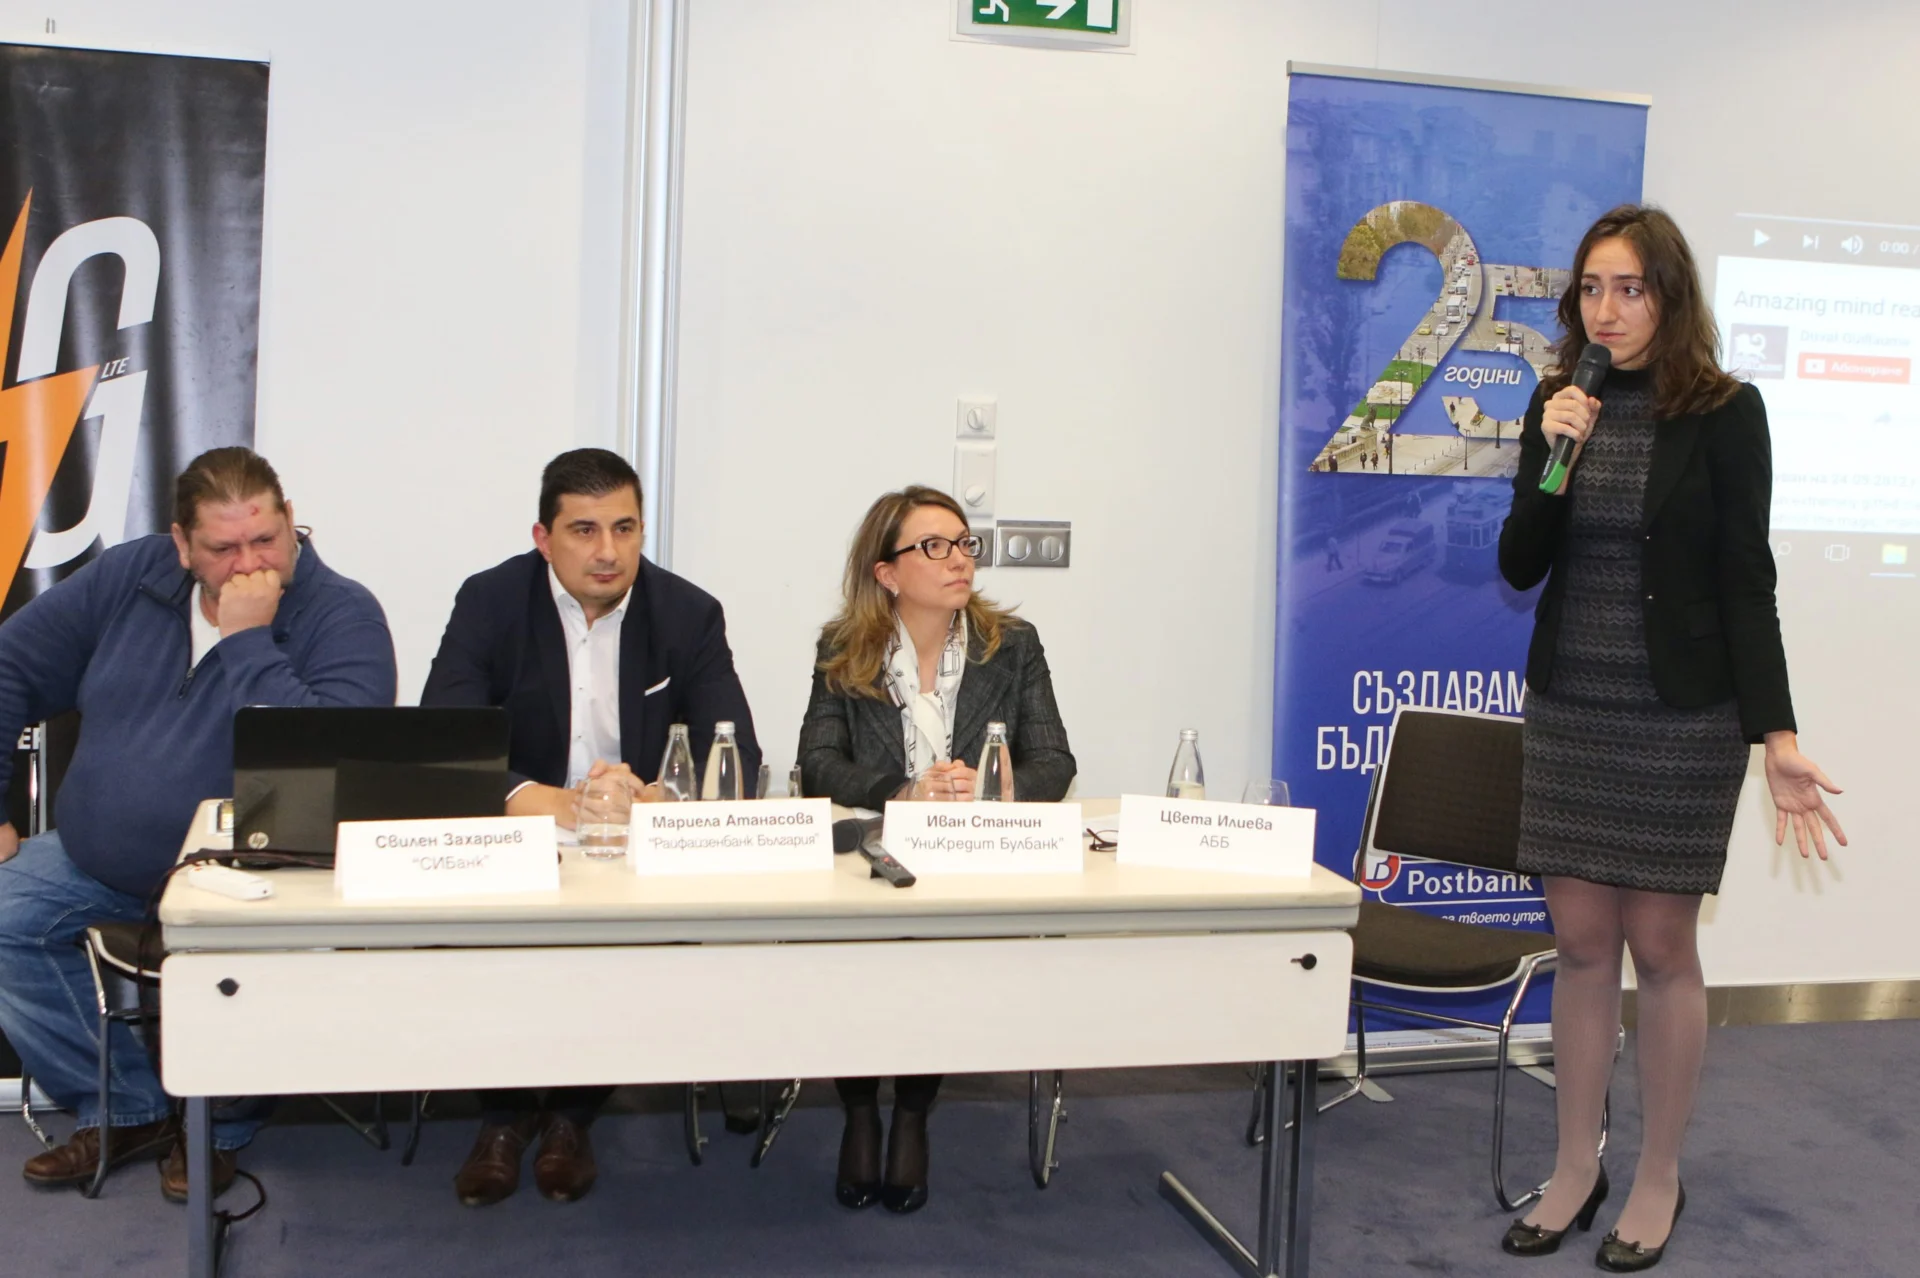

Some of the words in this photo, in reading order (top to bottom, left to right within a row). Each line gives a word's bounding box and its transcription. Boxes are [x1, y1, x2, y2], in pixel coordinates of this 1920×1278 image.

[1734, 290, 1827, 316] Amazing
[1834, 296, 1885, 316] mind
[100, 356, 130, 379] LTE
[1444, 366, 1522, 389] години
[1316, 726, 1395, 774] БЪД
[652, 815, 721, 830] Мариела
[726, 812, 813, 827] Атанасова
[927, 815, 966, 828] Иван
[971, 815, 1042, 828] Станчин
[1160, 810, 1212, 826] Цвета
[1217, 814, 1273, 831] Илиева
[375, 834, 438, 849] Свилен
[443, 830, 523, 848] Захариев
[1199, 834, 1230, 849] АББ
[1407, 869, 1533, 895] Postbank
[1458, 911, 1510, 924] твоето
[1512, 911, 1546, 926] утре
